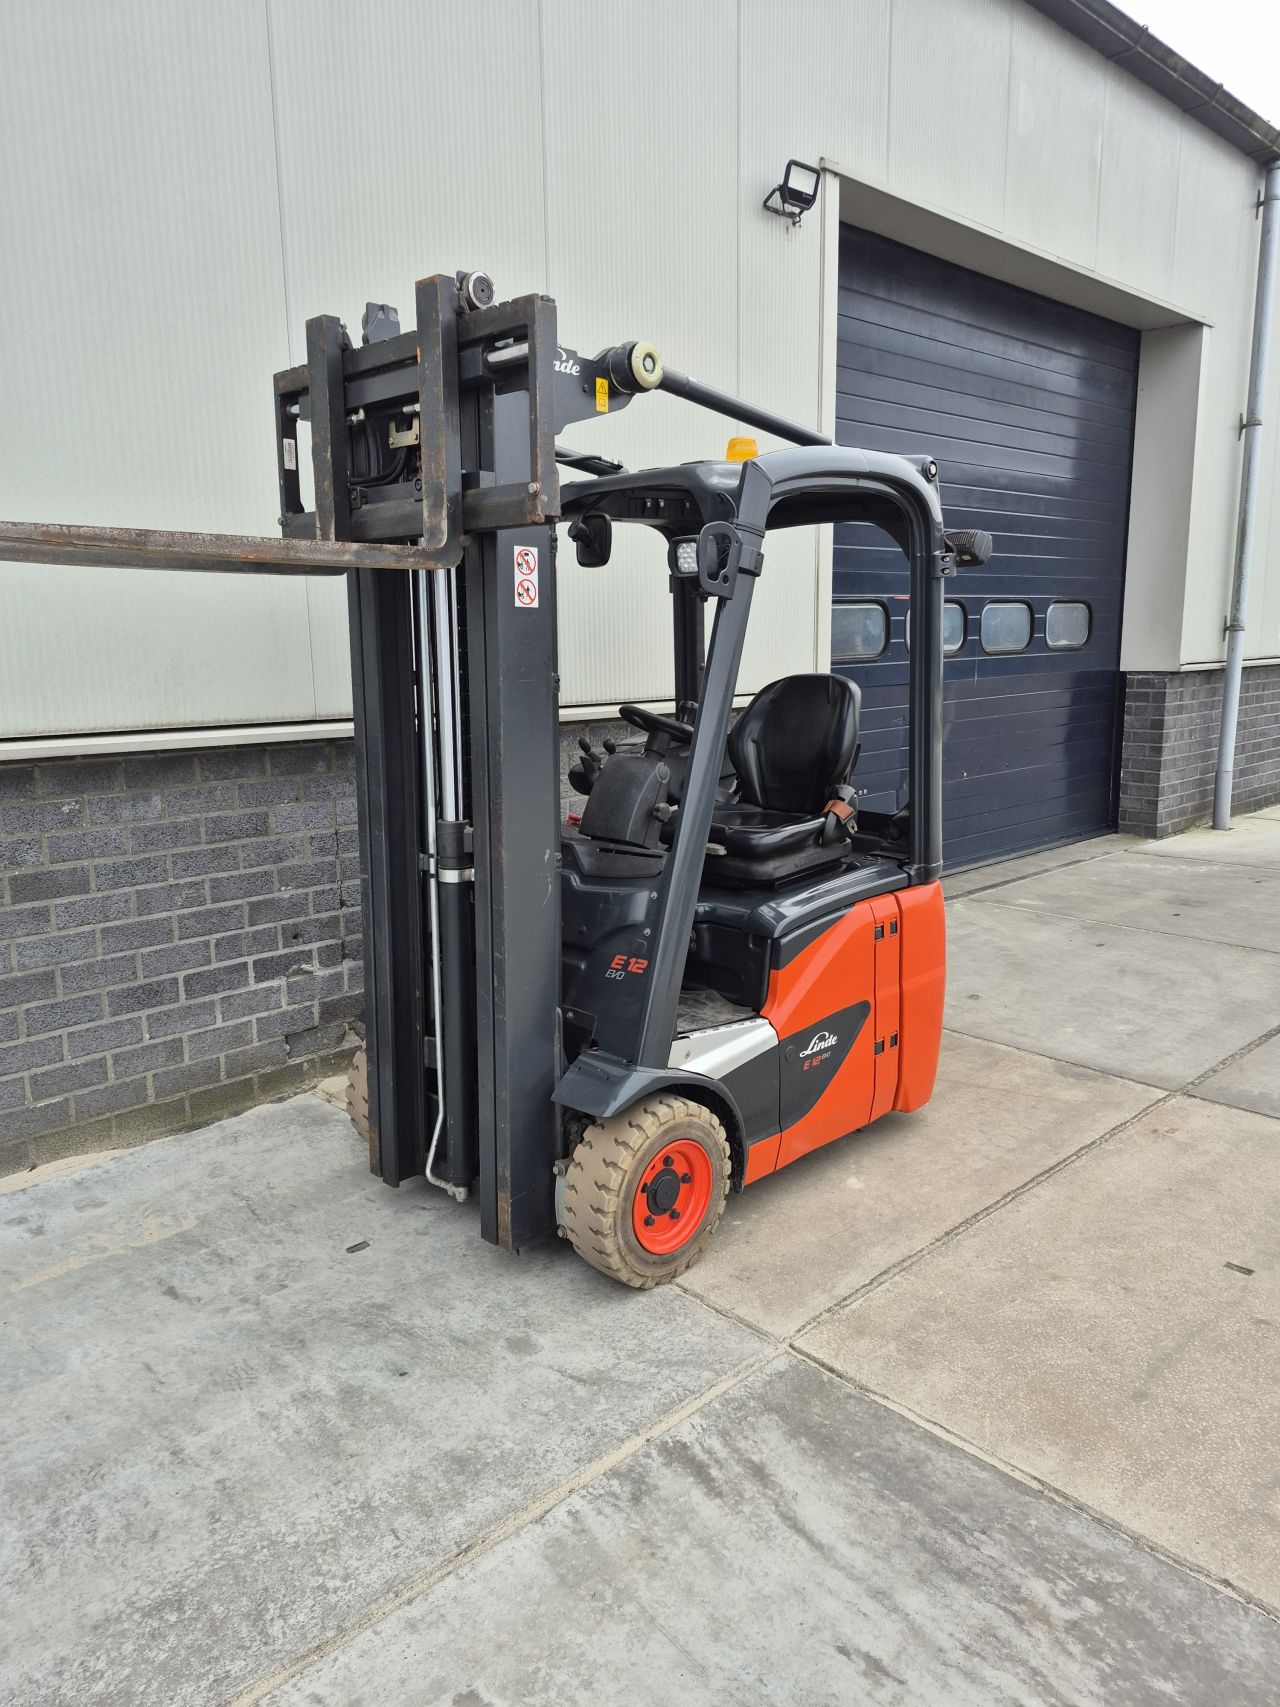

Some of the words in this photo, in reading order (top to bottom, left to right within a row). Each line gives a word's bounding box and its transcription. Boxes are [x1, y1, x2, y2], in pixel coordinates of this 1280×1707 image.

[553, 348, 580, 376] nde
[605, 969, 626, 981] EVO
[611, 955, 628, 970] E
[627, 957, 649, 974] 12
[799, 1031, 838, 1058] Linde
